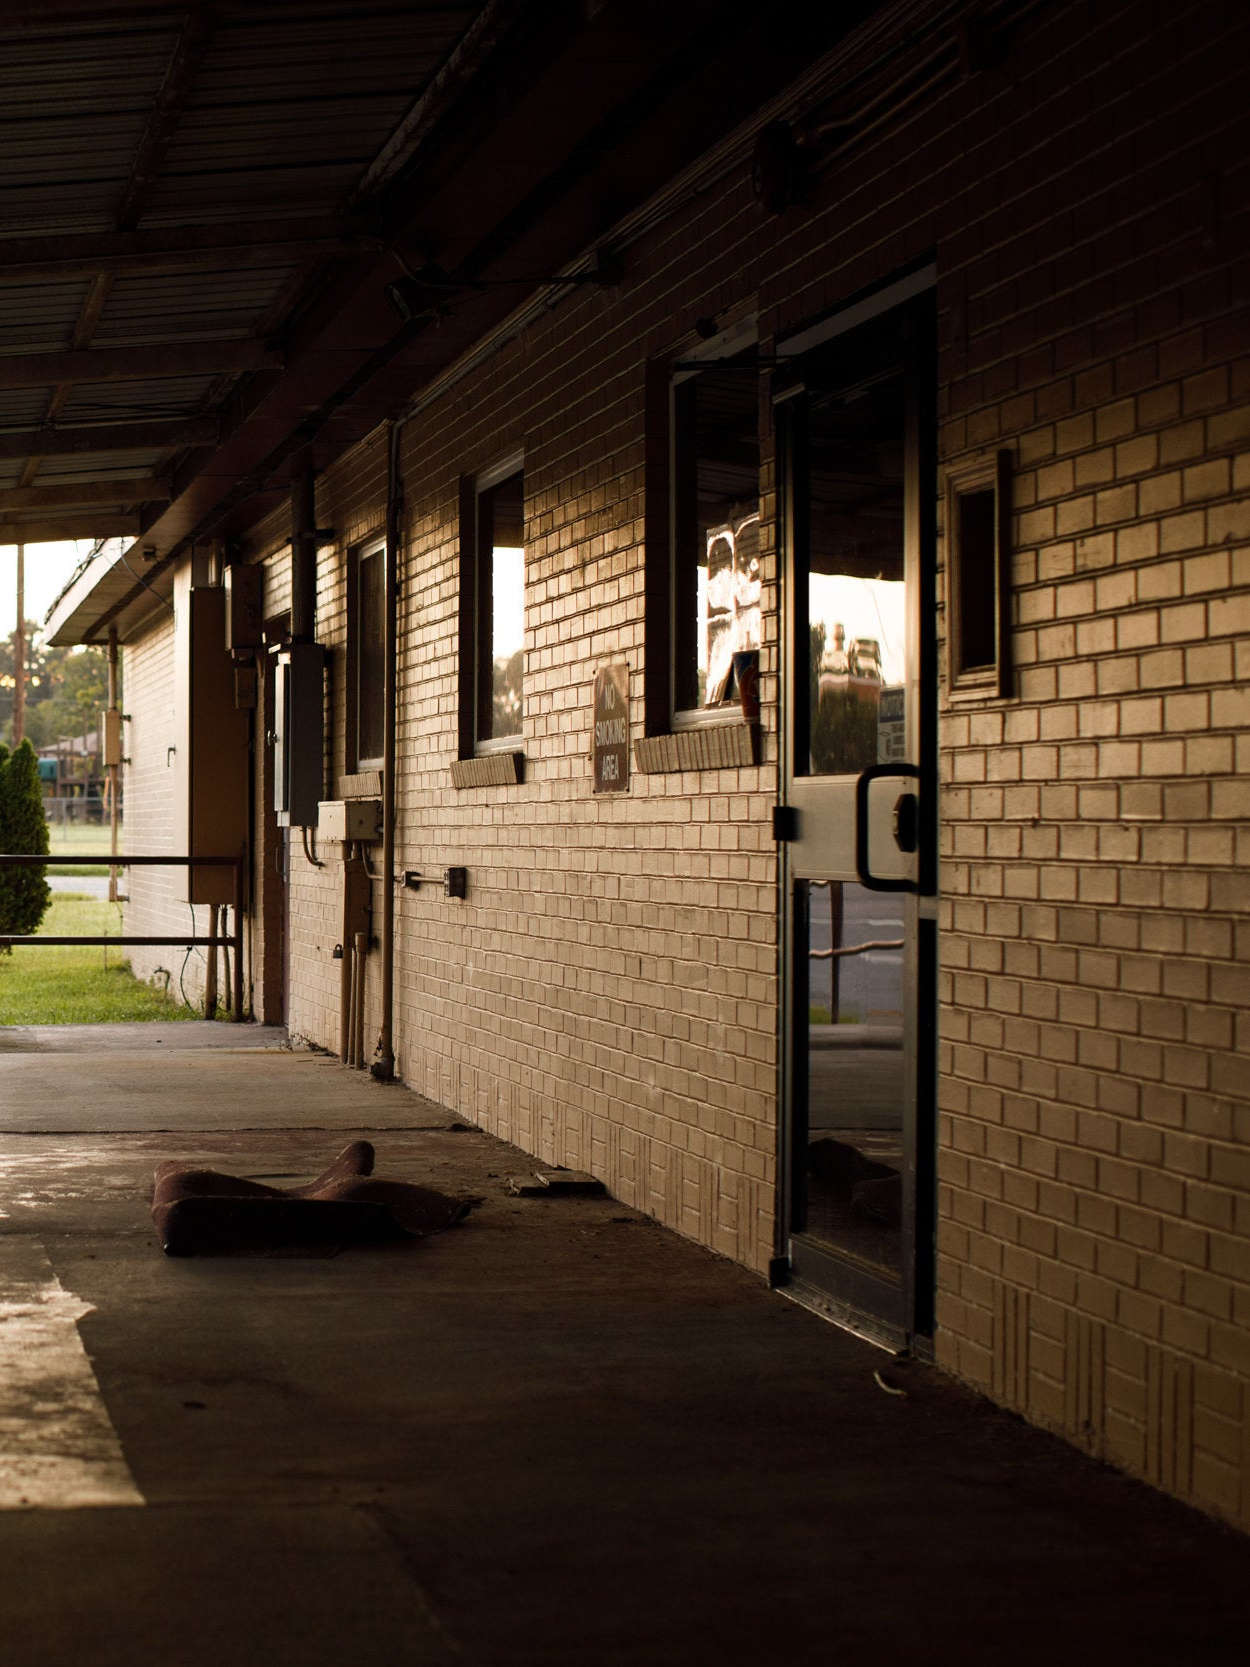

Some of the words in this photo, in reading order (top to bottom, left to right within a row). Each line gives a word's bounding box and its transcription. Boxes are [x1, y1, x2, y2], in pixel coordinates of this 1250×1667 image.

[604, 684, 615, 710] NO
[595, 717, 626, 748] SMOKING
[602, 754, 620, 781] AREA
